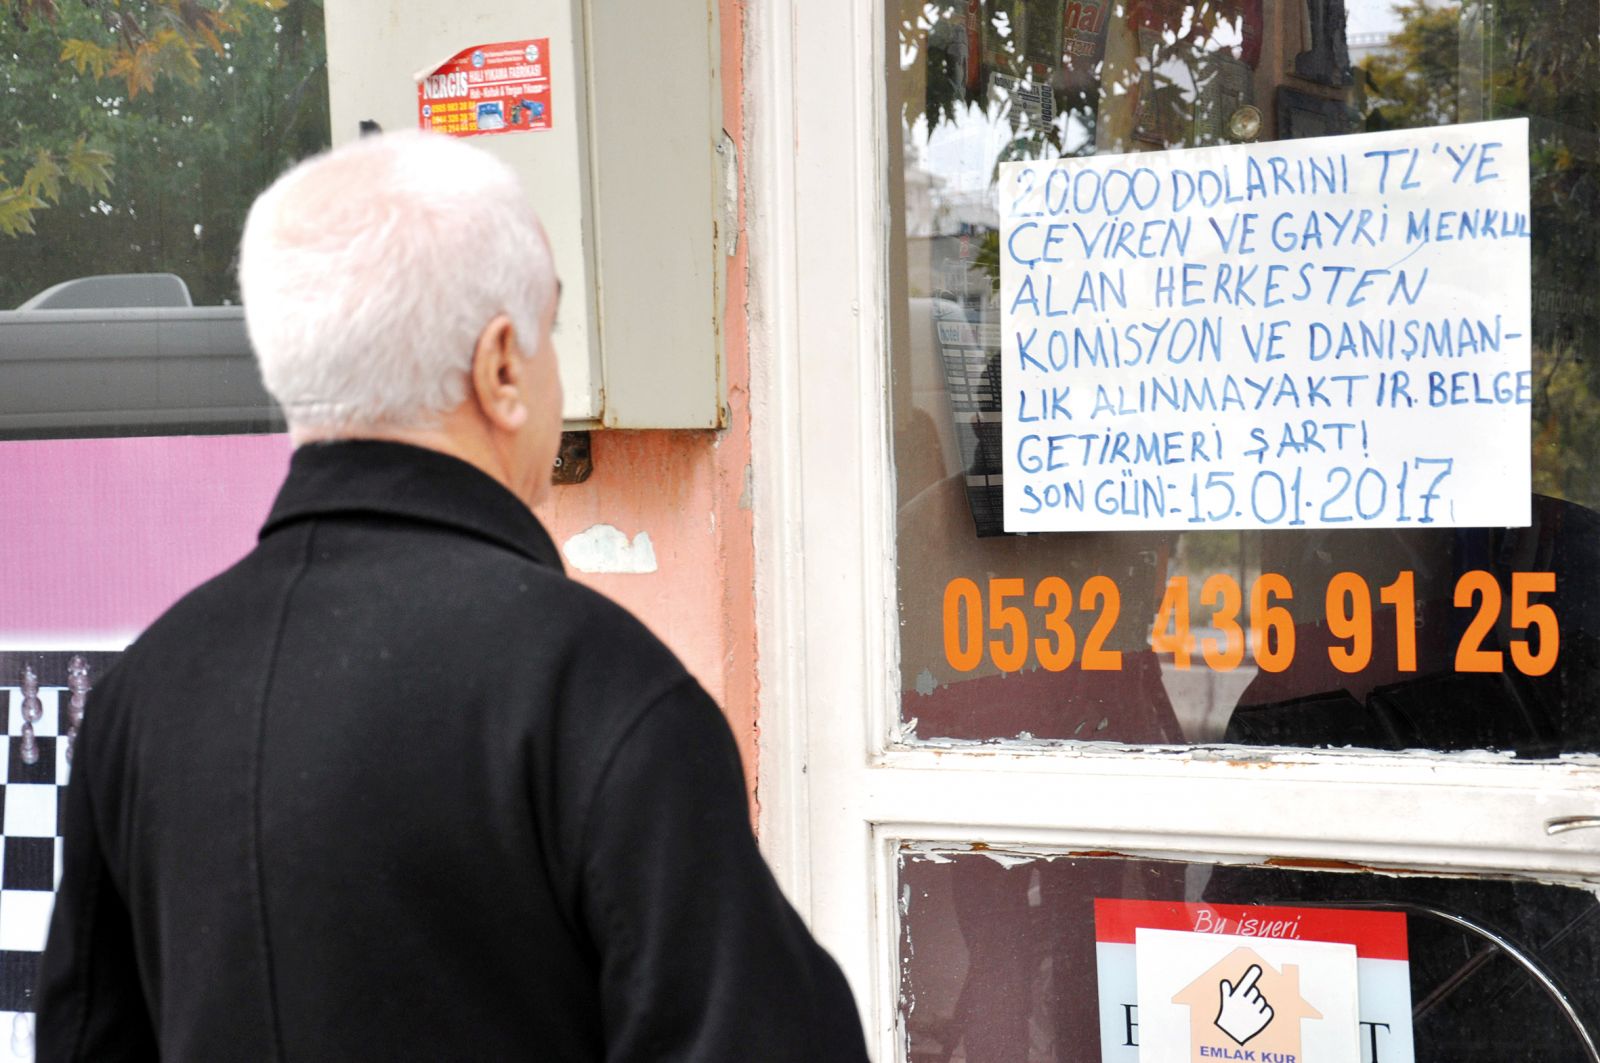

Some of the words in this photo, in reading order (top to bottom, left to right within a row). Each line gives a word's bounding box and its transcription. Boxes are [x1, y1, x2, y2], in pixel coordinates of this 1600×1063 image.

[423, 67, 468, 99] NERGİS
[1172, 153, 1347, 212] DOLARINI
[1008, 216, 1192, 270] ÇEVİREN
[1208, 212, 1259, 254] VE
[1271, 203, 1388, 252] GAYRİ
[1406, 208, 1531, 244] MENKUL
[1010, 268, 1127, 317] ALAN
[1156, 263, 1428, 308] HERKESTEN
[1016, 317, 1223, 373] KOMİSYON
[1241, 319, 1291, 363] VE
[1308, 314, 1522, 361] DANIŞMAN-
[1018, 386, 1072, 422] LIK
[1429, 370, 1531, 407] BELGE
[1017, 422, 1223, 473] GETİRMERİ
[1244, 419, 1369, 464] ŞART!
[1020, 479, 1084, 514] SON
[942, 575, 1122, 672] 0532
[1151, 573, 1296, 673] 436
[1325, 570, 1417, 673] 91
[1453, 570, 1560, 677] 25
[1194, 909, 1227, 934] Bu
[1200, 1046, 1256, 1061] EMLAK
[1261, 1052, 1296, 1063] KUR
